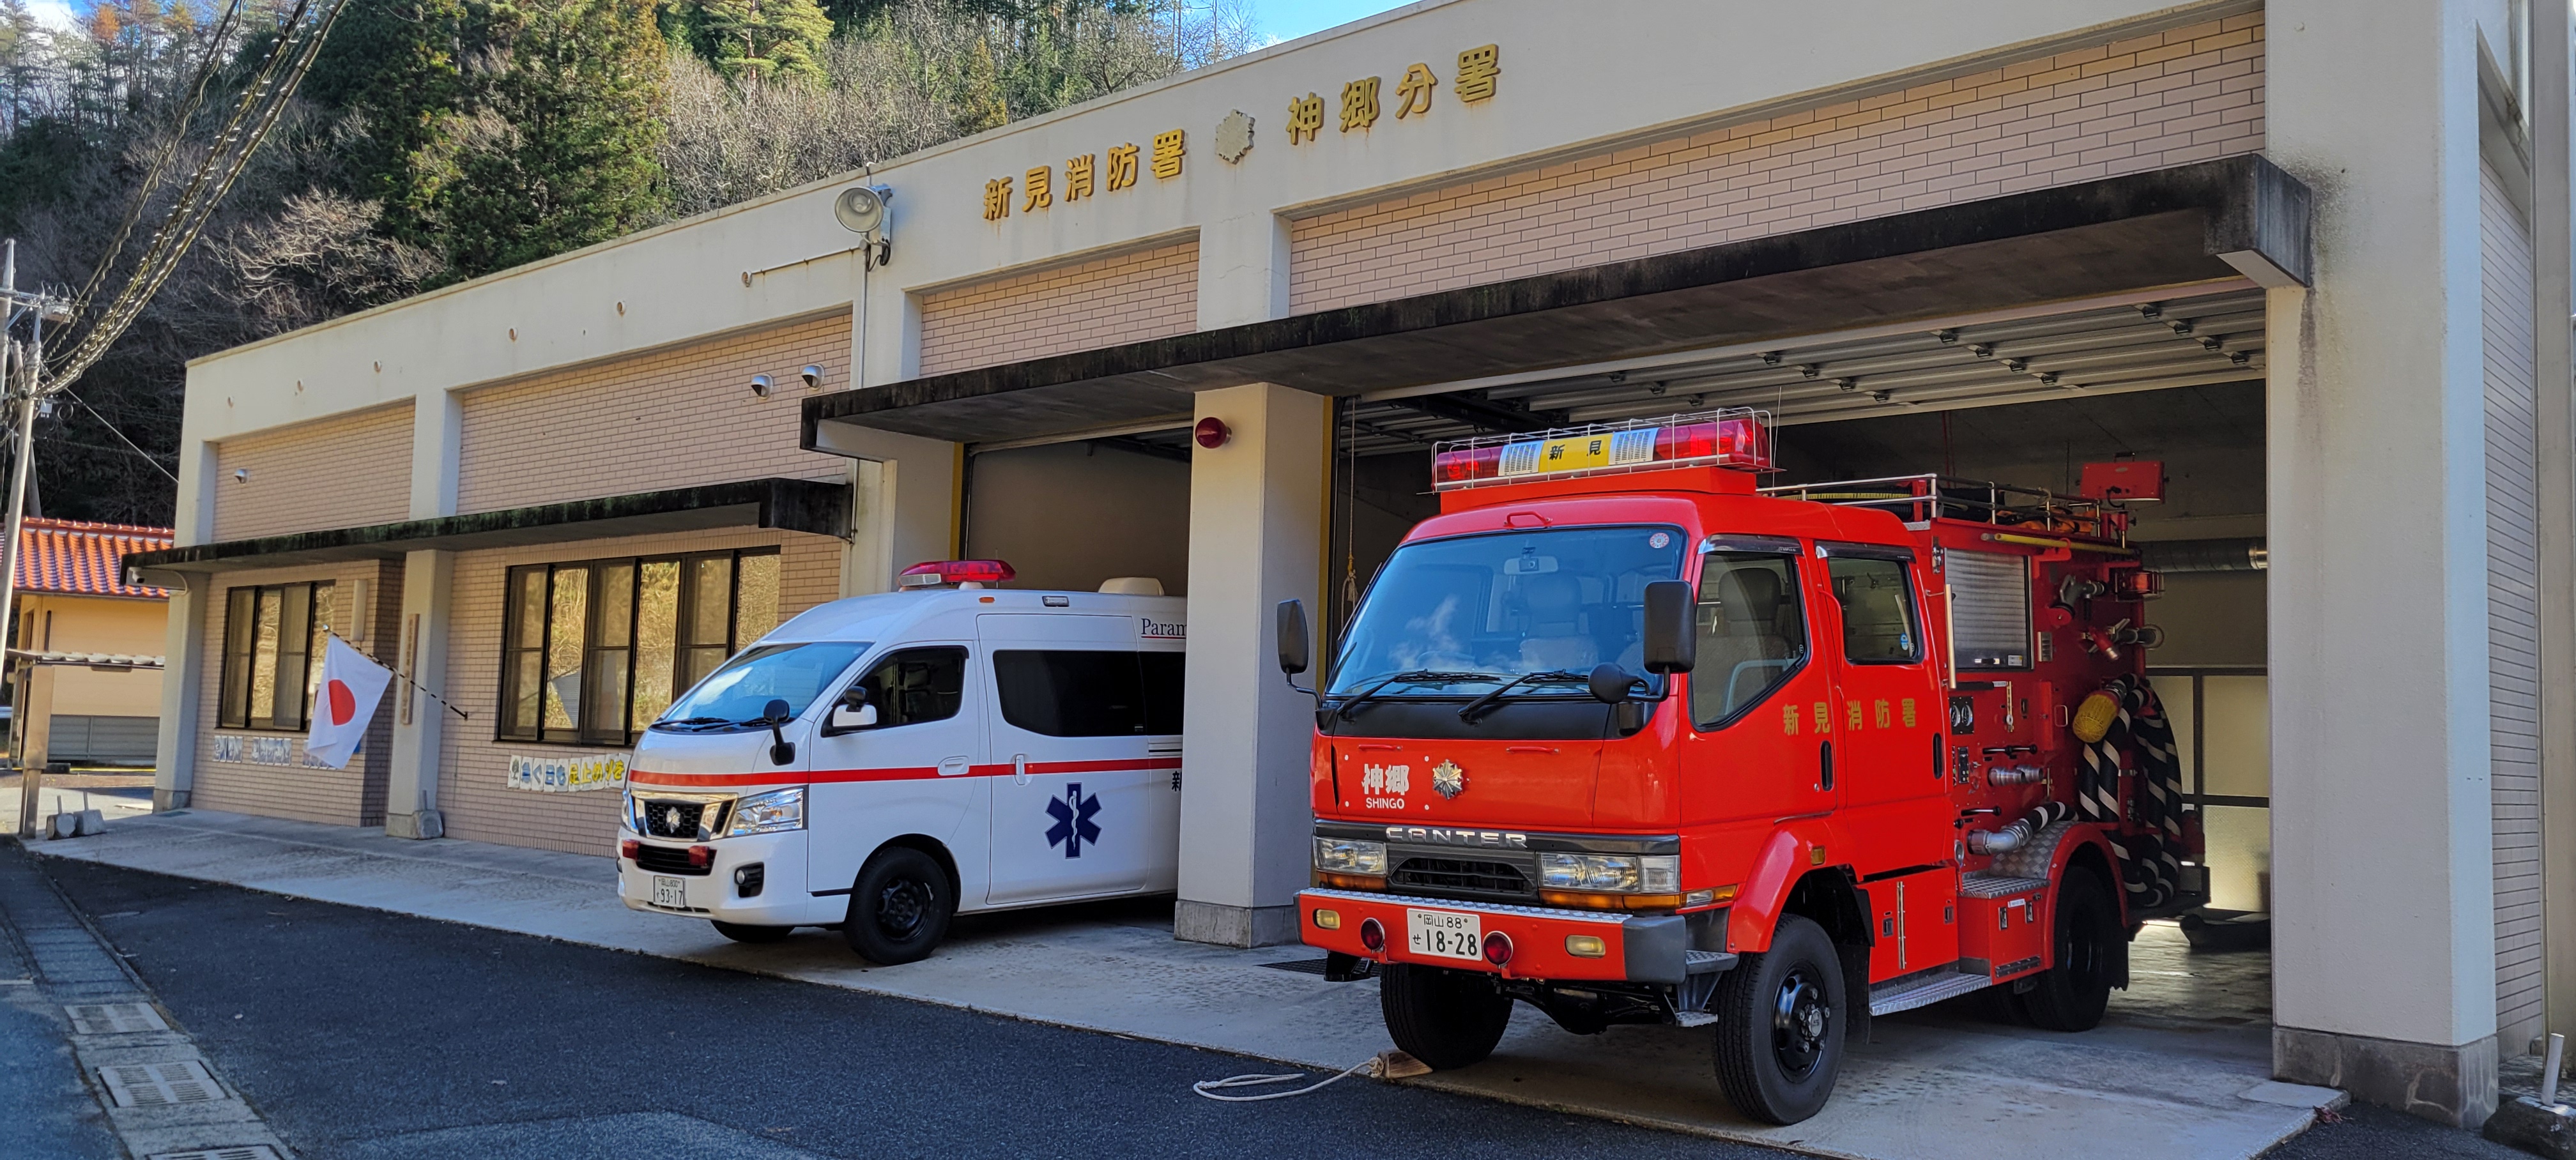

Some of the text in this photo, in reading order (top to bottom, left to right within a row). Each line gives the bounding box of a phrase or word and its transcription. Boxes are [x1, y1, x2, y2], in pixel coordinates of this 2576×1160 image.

[983, 43, 1501, 220] 新見消防署 神郷分署
[1549, 439, 1602, 461] 新見
[1361, 764, 1410, 795] 神郷
[1366, 797, 1405, 809] SHINGO
[1386, 827, 1528, 849] CANTER
[1426, 929, 1477, 956] 18-28
